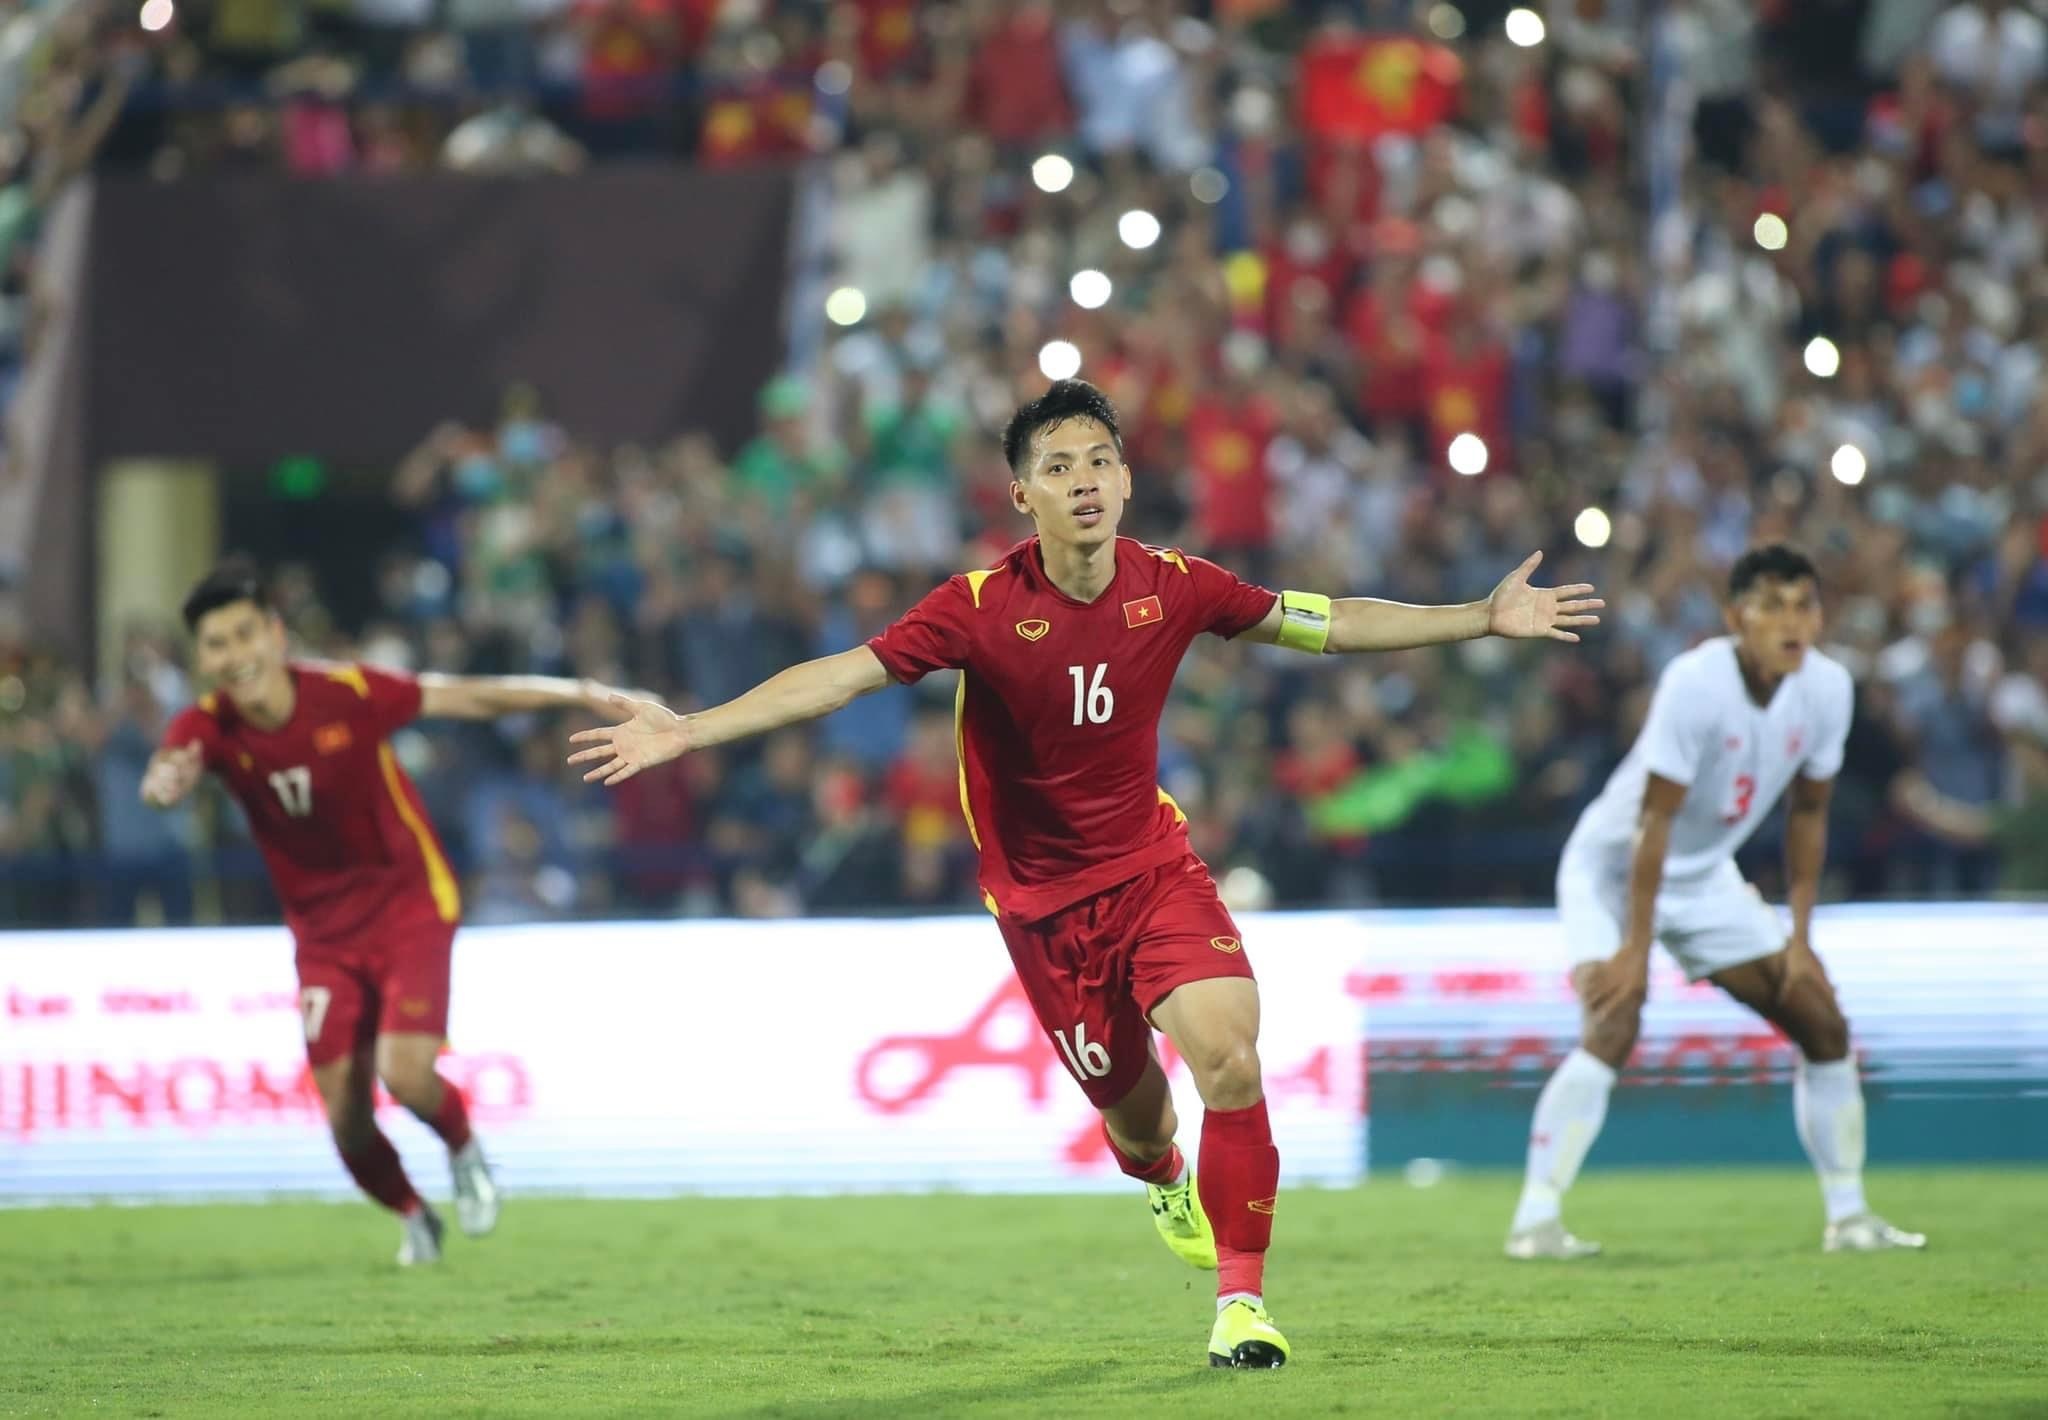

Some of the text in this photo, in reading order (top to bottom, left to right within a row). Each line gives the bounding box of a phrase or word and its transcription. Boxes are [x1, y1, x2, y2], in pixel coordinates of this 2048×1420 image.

[1068, 663, 1114, 726] 16
[268, 765, 311, 816] 17
[1720, 775, 1757, 826] 3
[1053, 1021, 1112, 1081] 16
